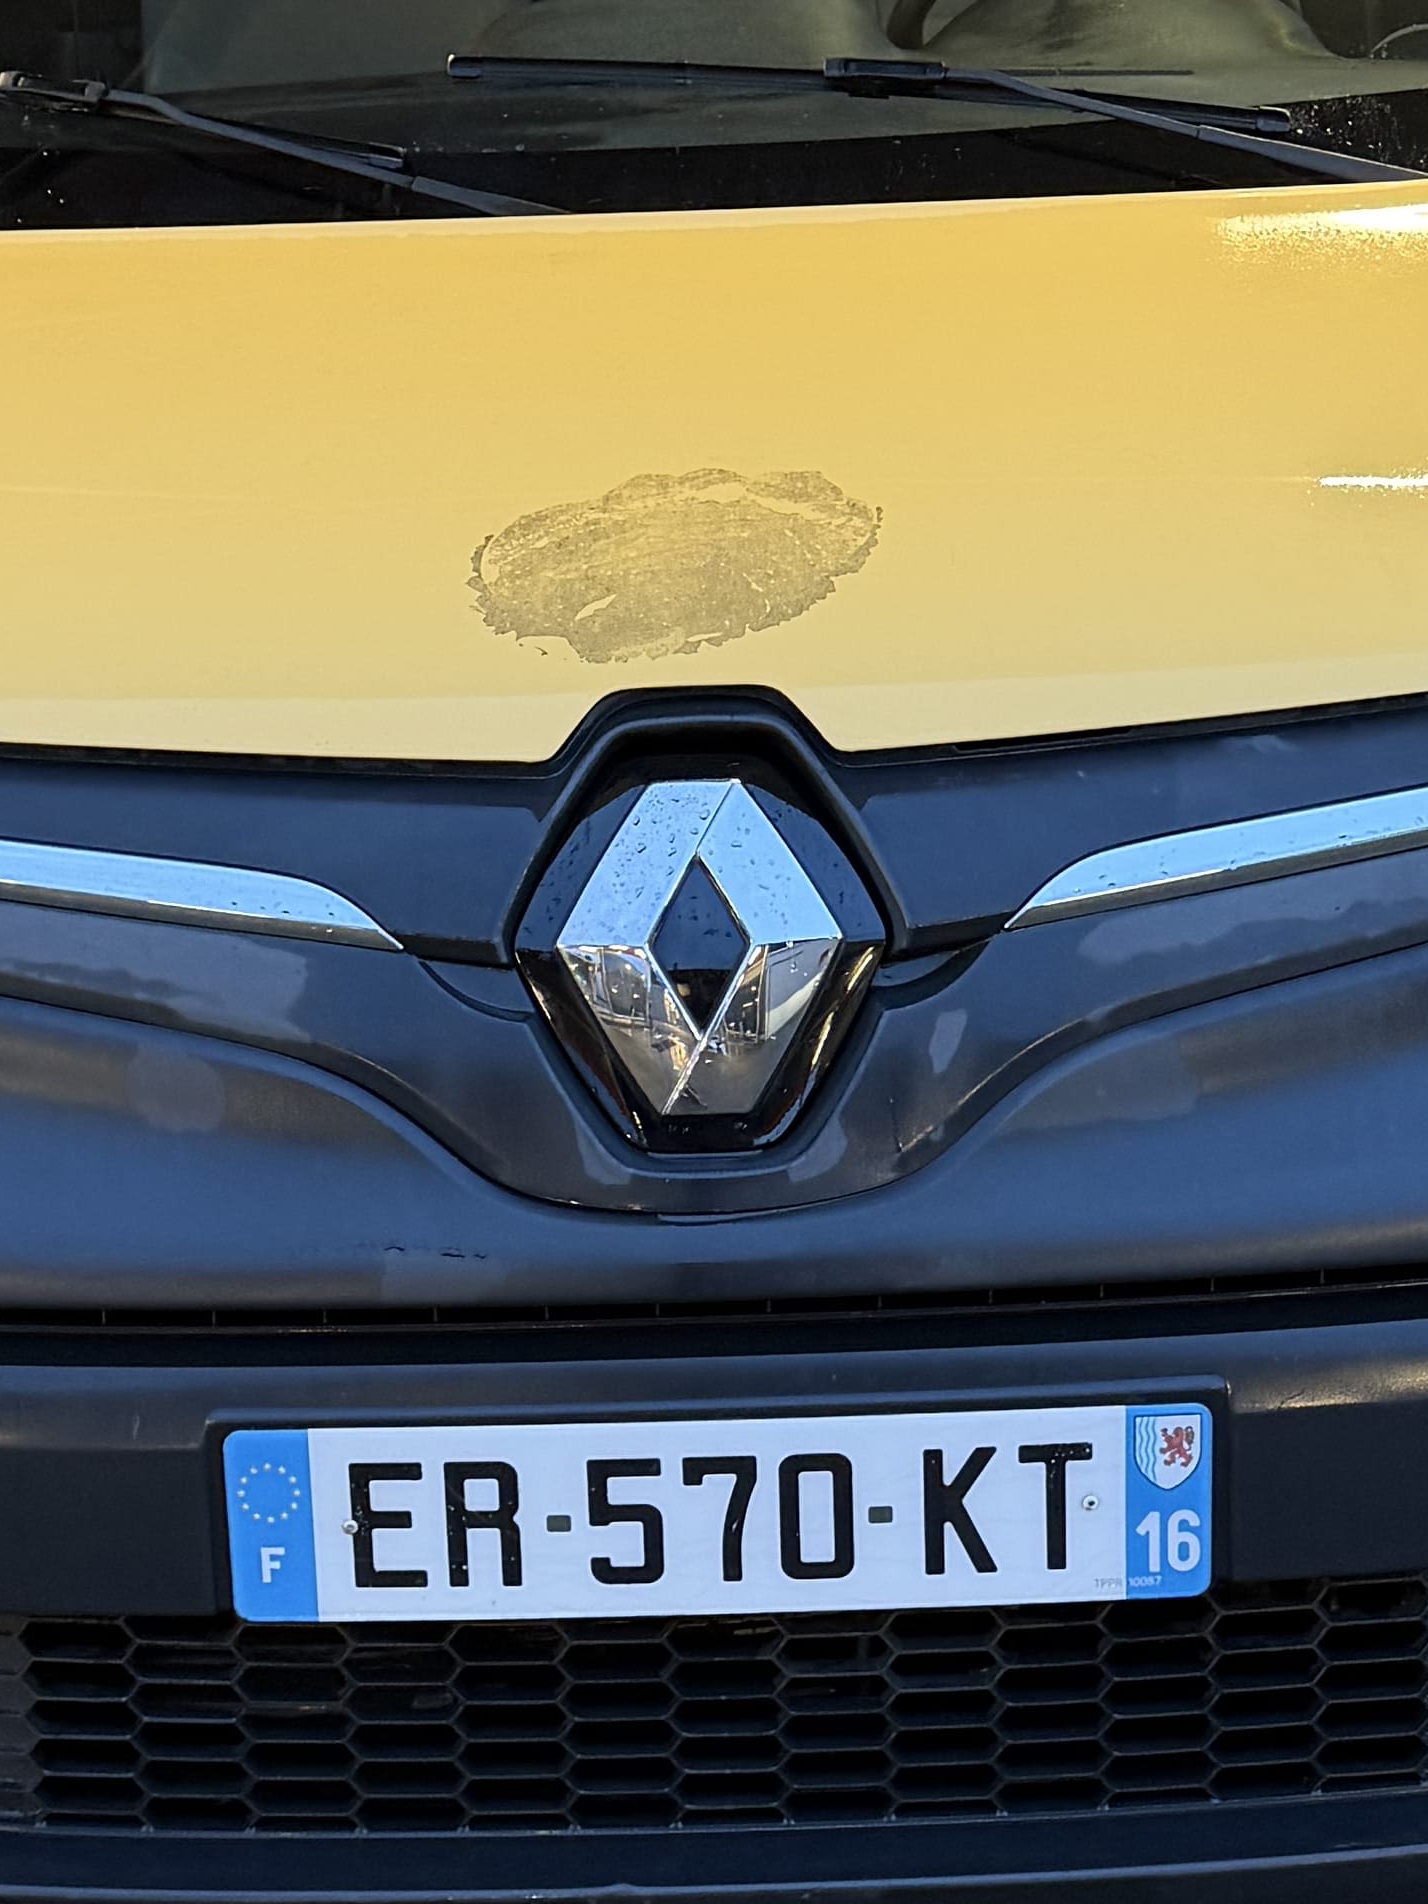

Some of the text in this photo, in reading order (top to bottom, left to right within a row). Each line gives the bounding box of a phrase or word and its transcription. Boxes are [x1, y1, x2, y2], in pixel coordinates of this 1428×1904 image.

[347, 1441, 1094, 1589] ER-570-KT
[1136, 1508, 1202, 1573] 16
[260, 1546, 286, 1584] F
